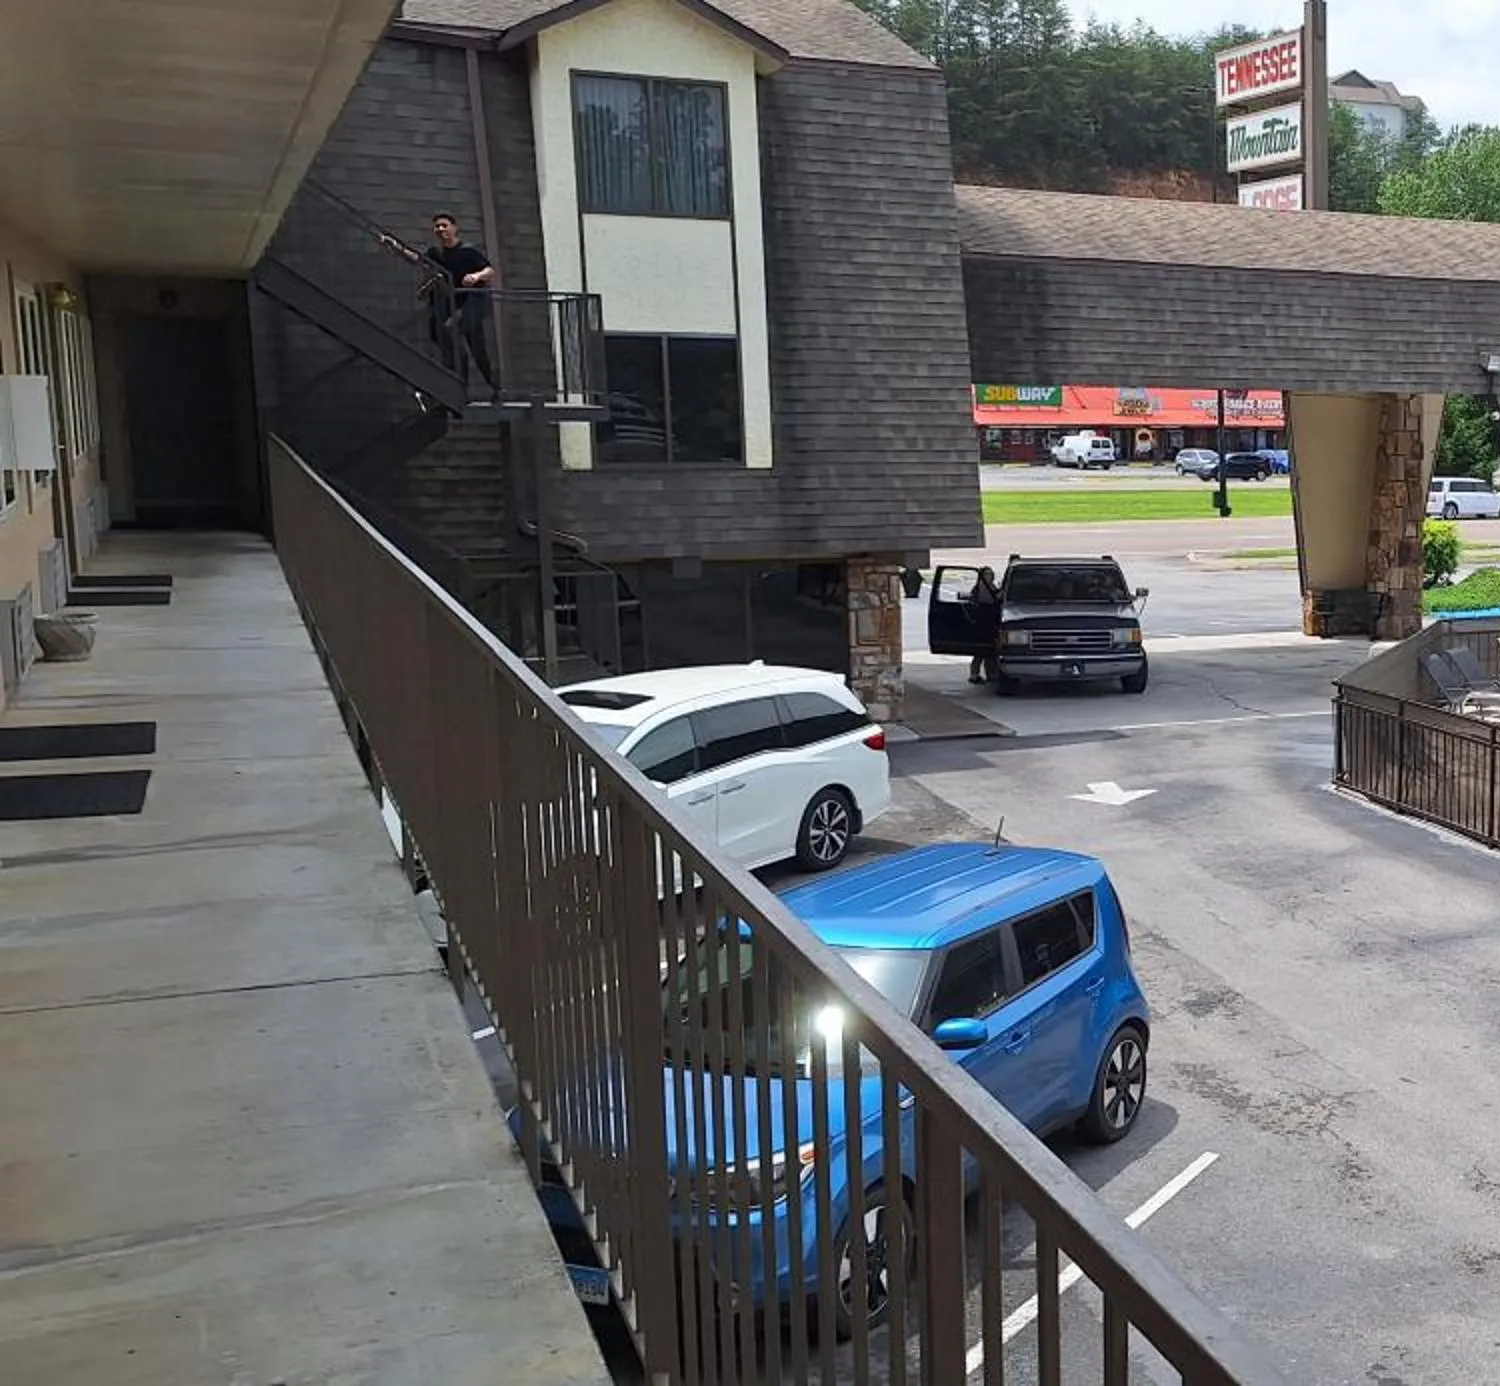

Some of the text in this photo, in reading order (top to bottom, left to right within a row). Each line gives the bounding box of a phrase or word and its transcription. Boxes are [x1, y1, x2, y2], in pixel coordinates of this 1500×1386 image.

[1218, 40, 1297, 96] TENNESSEE
[1229, 117, 1298, 164] Mountain
[984, 385, 1057, 401] SUBWAY
